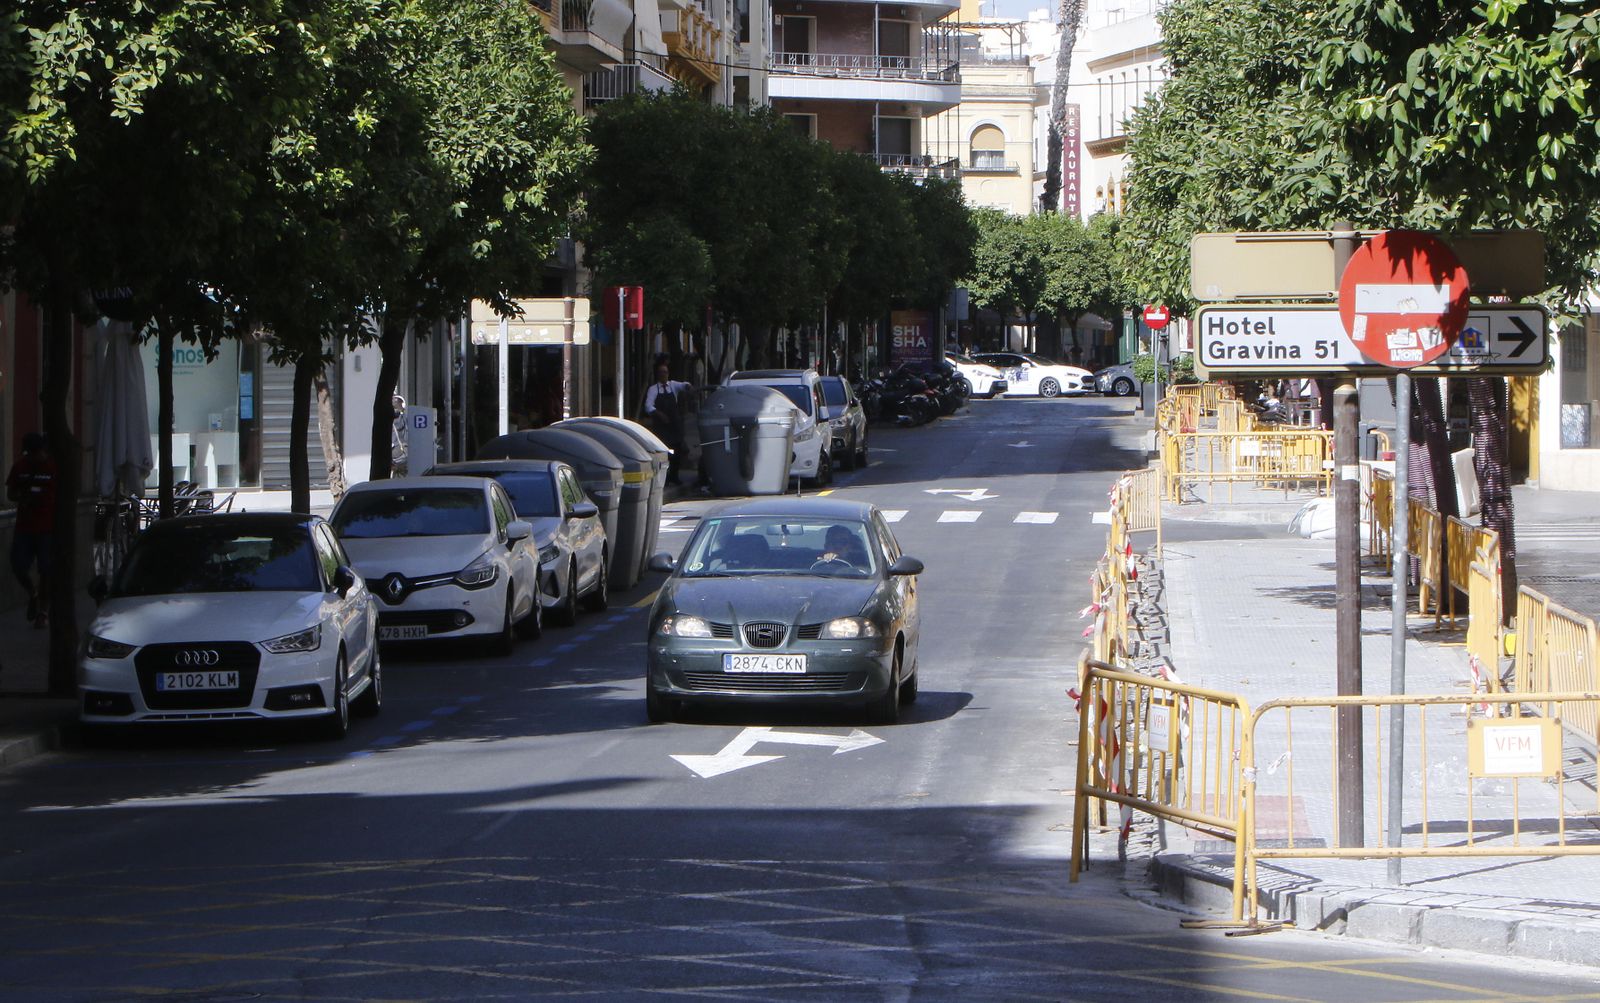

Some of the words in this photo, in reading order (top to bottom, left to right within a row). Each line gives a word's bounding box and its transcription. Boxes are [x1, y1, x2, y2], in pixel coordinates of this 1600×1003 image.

[893, 325, 920, 336] SHI
[1208, 316, 1274, 336] Hotel
[893, 336, 927, 348] SHA
[1208, 340, 1300, 359] Gravina
[1314, 340, 1338, 359] 51
[403, 626, 425, 638] HXH
[733, 656, 768, 670] 2874
[776, 657, 803, 671] CKN
[167, 674, 203, 689] 2102
[208, 673, 236, 687] KLM
[1495, 736, 1531, 752] VFM
